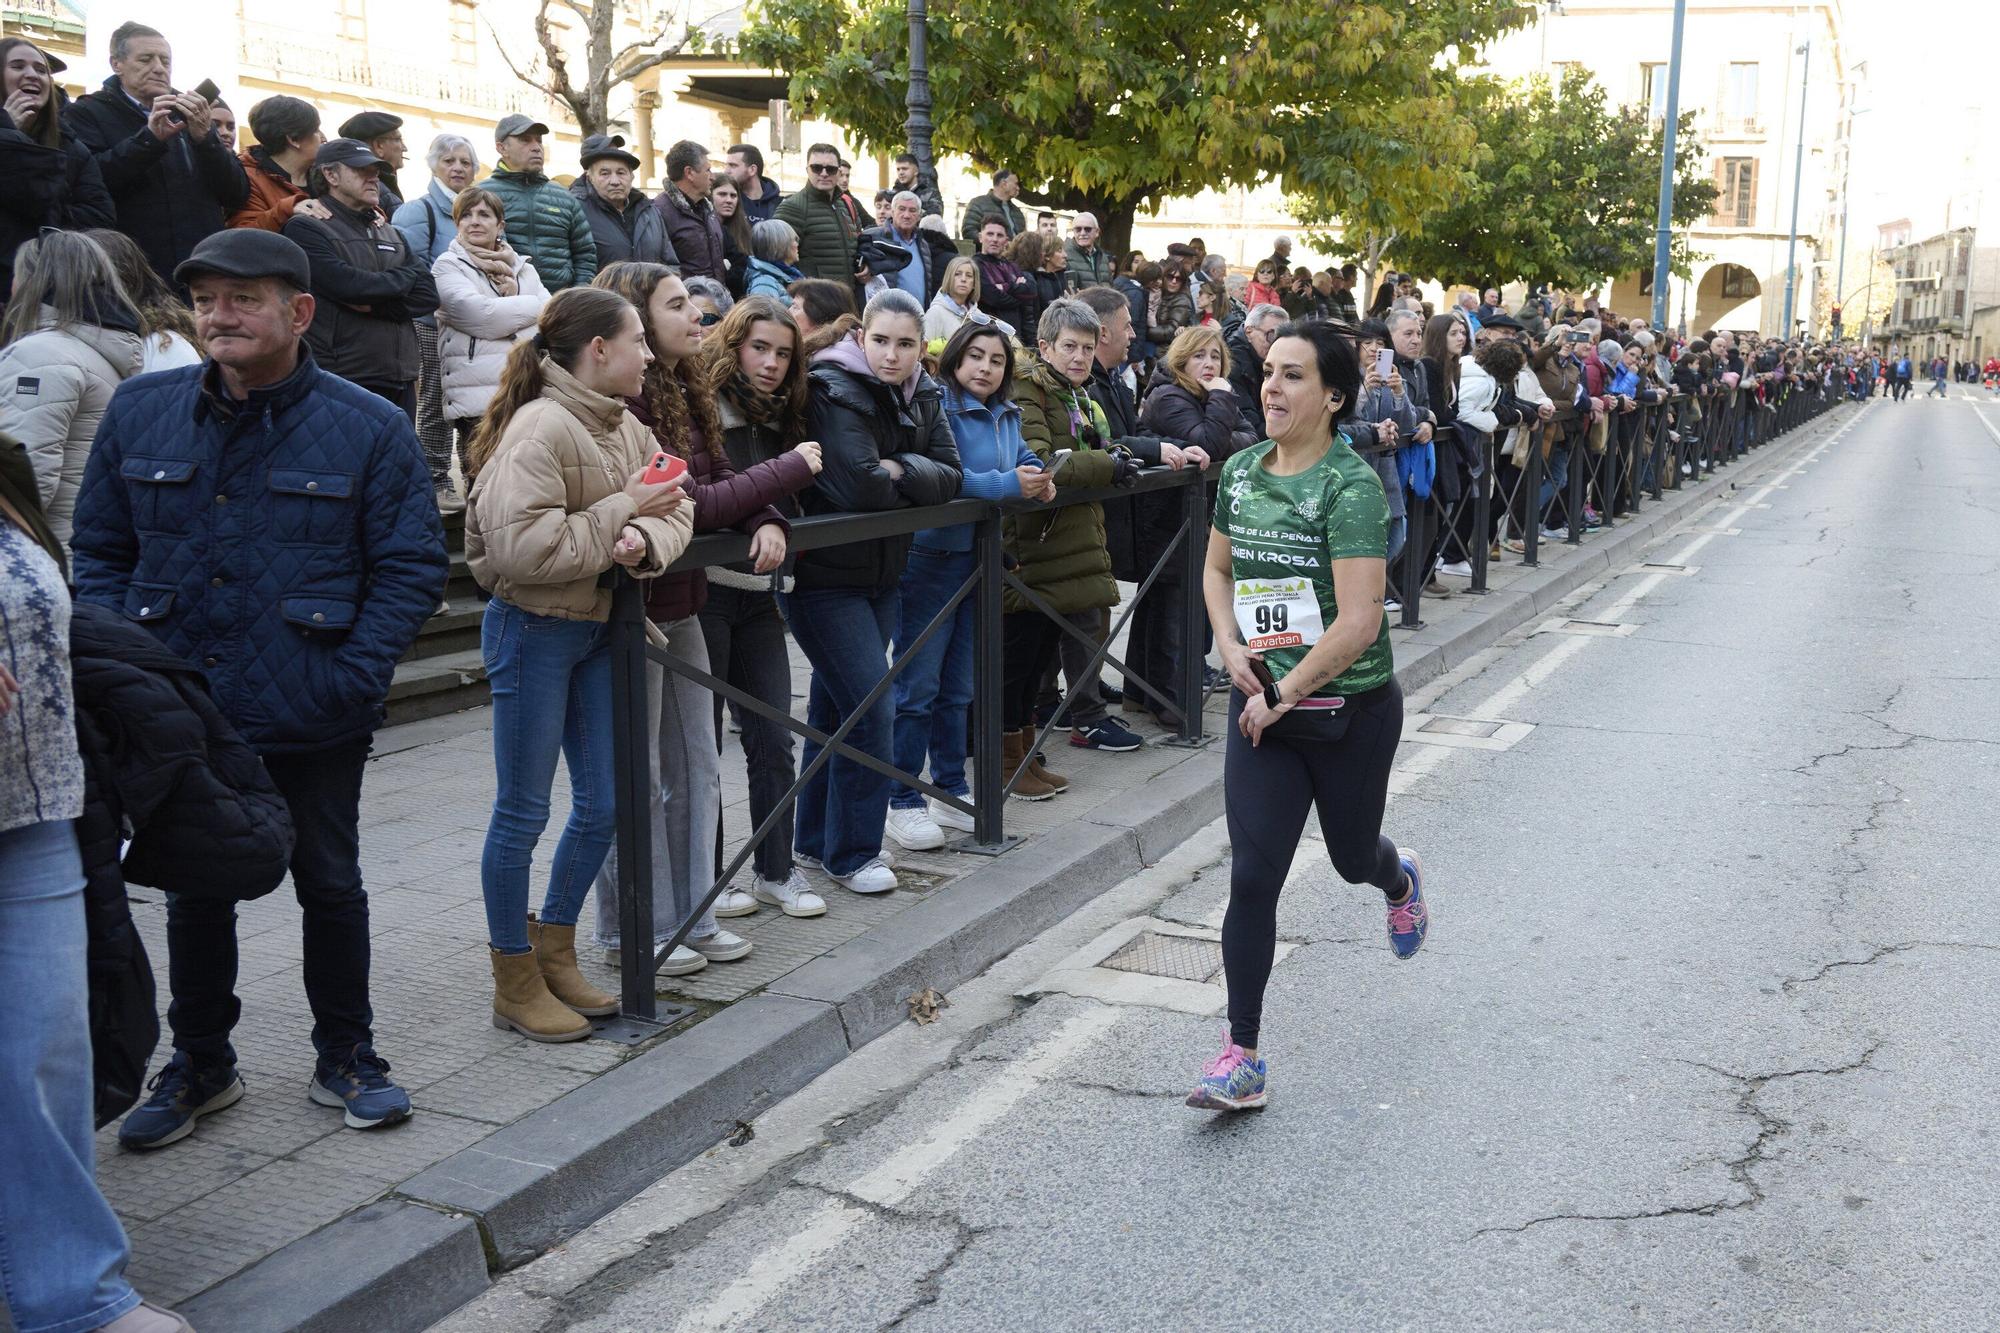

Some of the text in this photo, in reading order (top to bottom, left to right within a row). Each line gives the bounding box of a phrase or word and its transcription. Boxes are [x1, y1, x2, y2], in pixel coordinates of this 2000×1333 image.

[1228, 523, 1322, 543] ROSS DE LAS PEÑAS
[1231, 544, 1320, 567] EÑEN KROSA
[1255, 603, 1288, 634] 99
[1250, 635, 1300, 648] navarban
